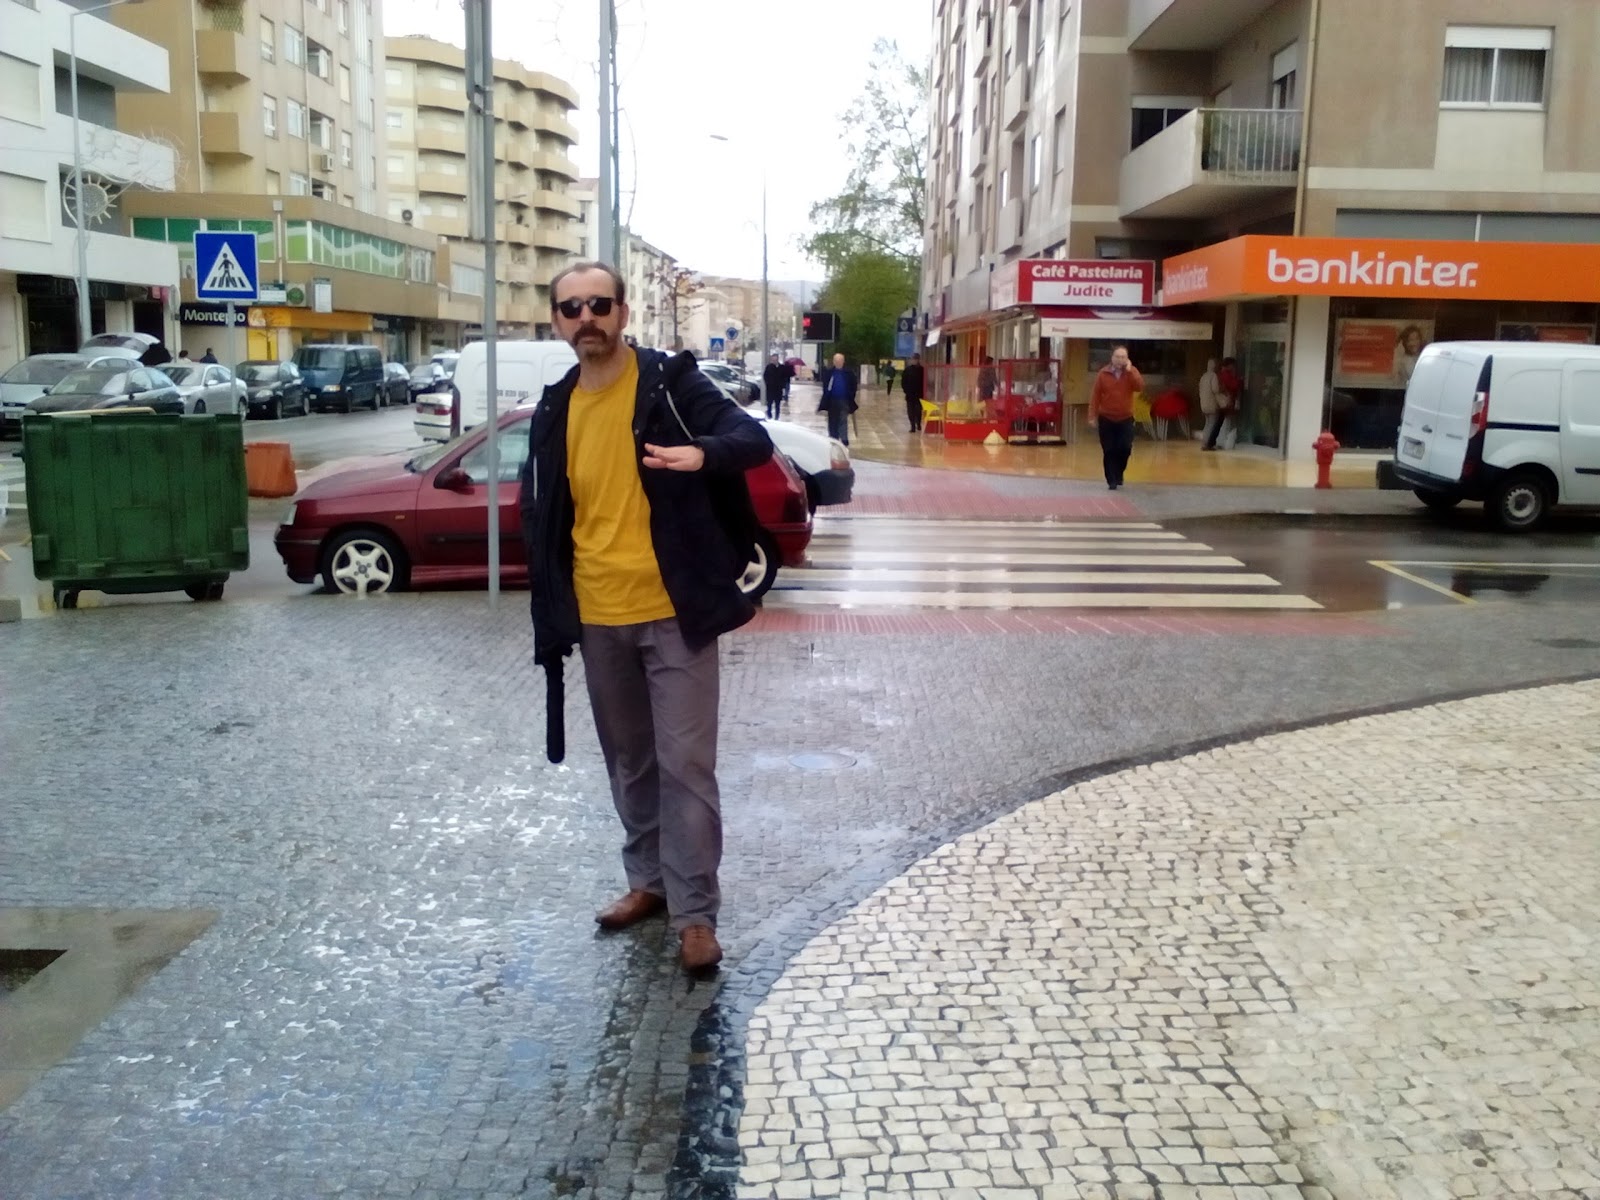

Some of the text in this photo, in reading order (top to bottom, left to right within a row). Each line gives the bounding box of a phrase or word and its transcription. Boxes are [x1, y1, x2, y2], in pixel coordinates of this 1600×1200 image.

[1031, 264, 1143, 279] Café Pastelaria
[1267, 248, 1479, 287] bankinter.
[1063, 284, 1114, 298] Judite
